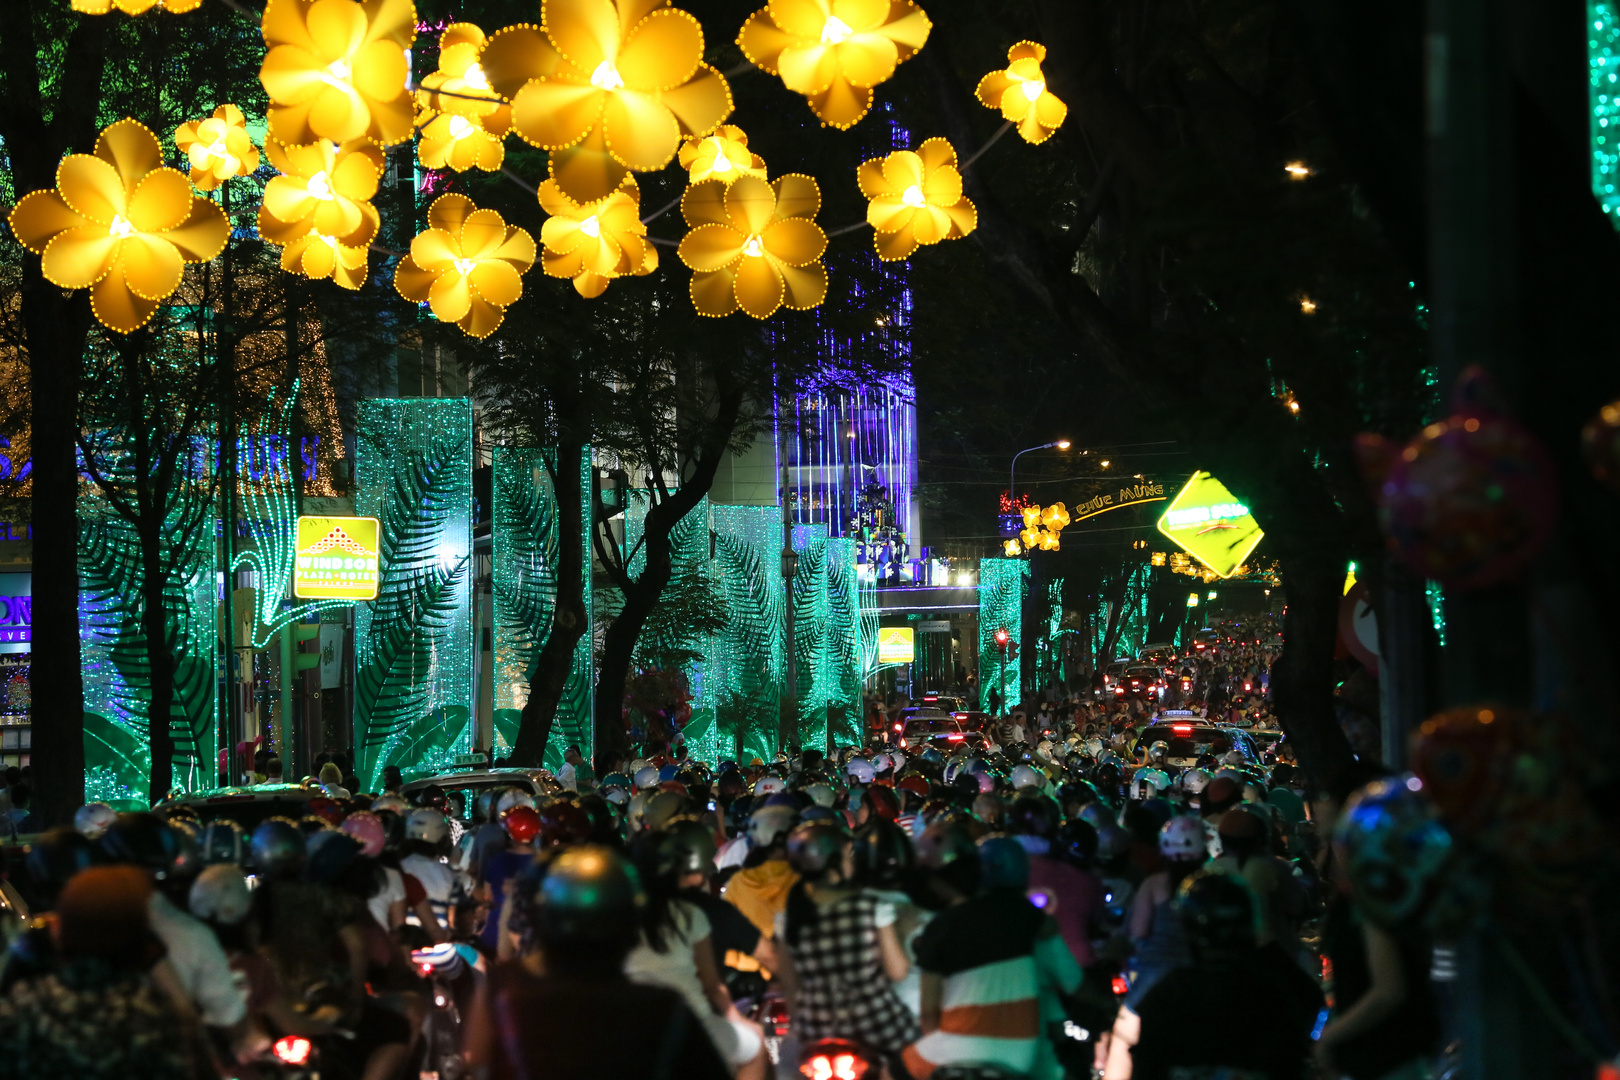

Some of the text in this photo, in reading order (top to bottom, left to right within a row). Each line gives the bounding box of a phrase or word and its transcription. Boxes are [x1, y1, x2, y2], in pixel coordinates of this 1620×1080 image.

[298, 556, 377, 570] WINDSOR
[297, 570, 377, 580] PLAZA HOTEL
